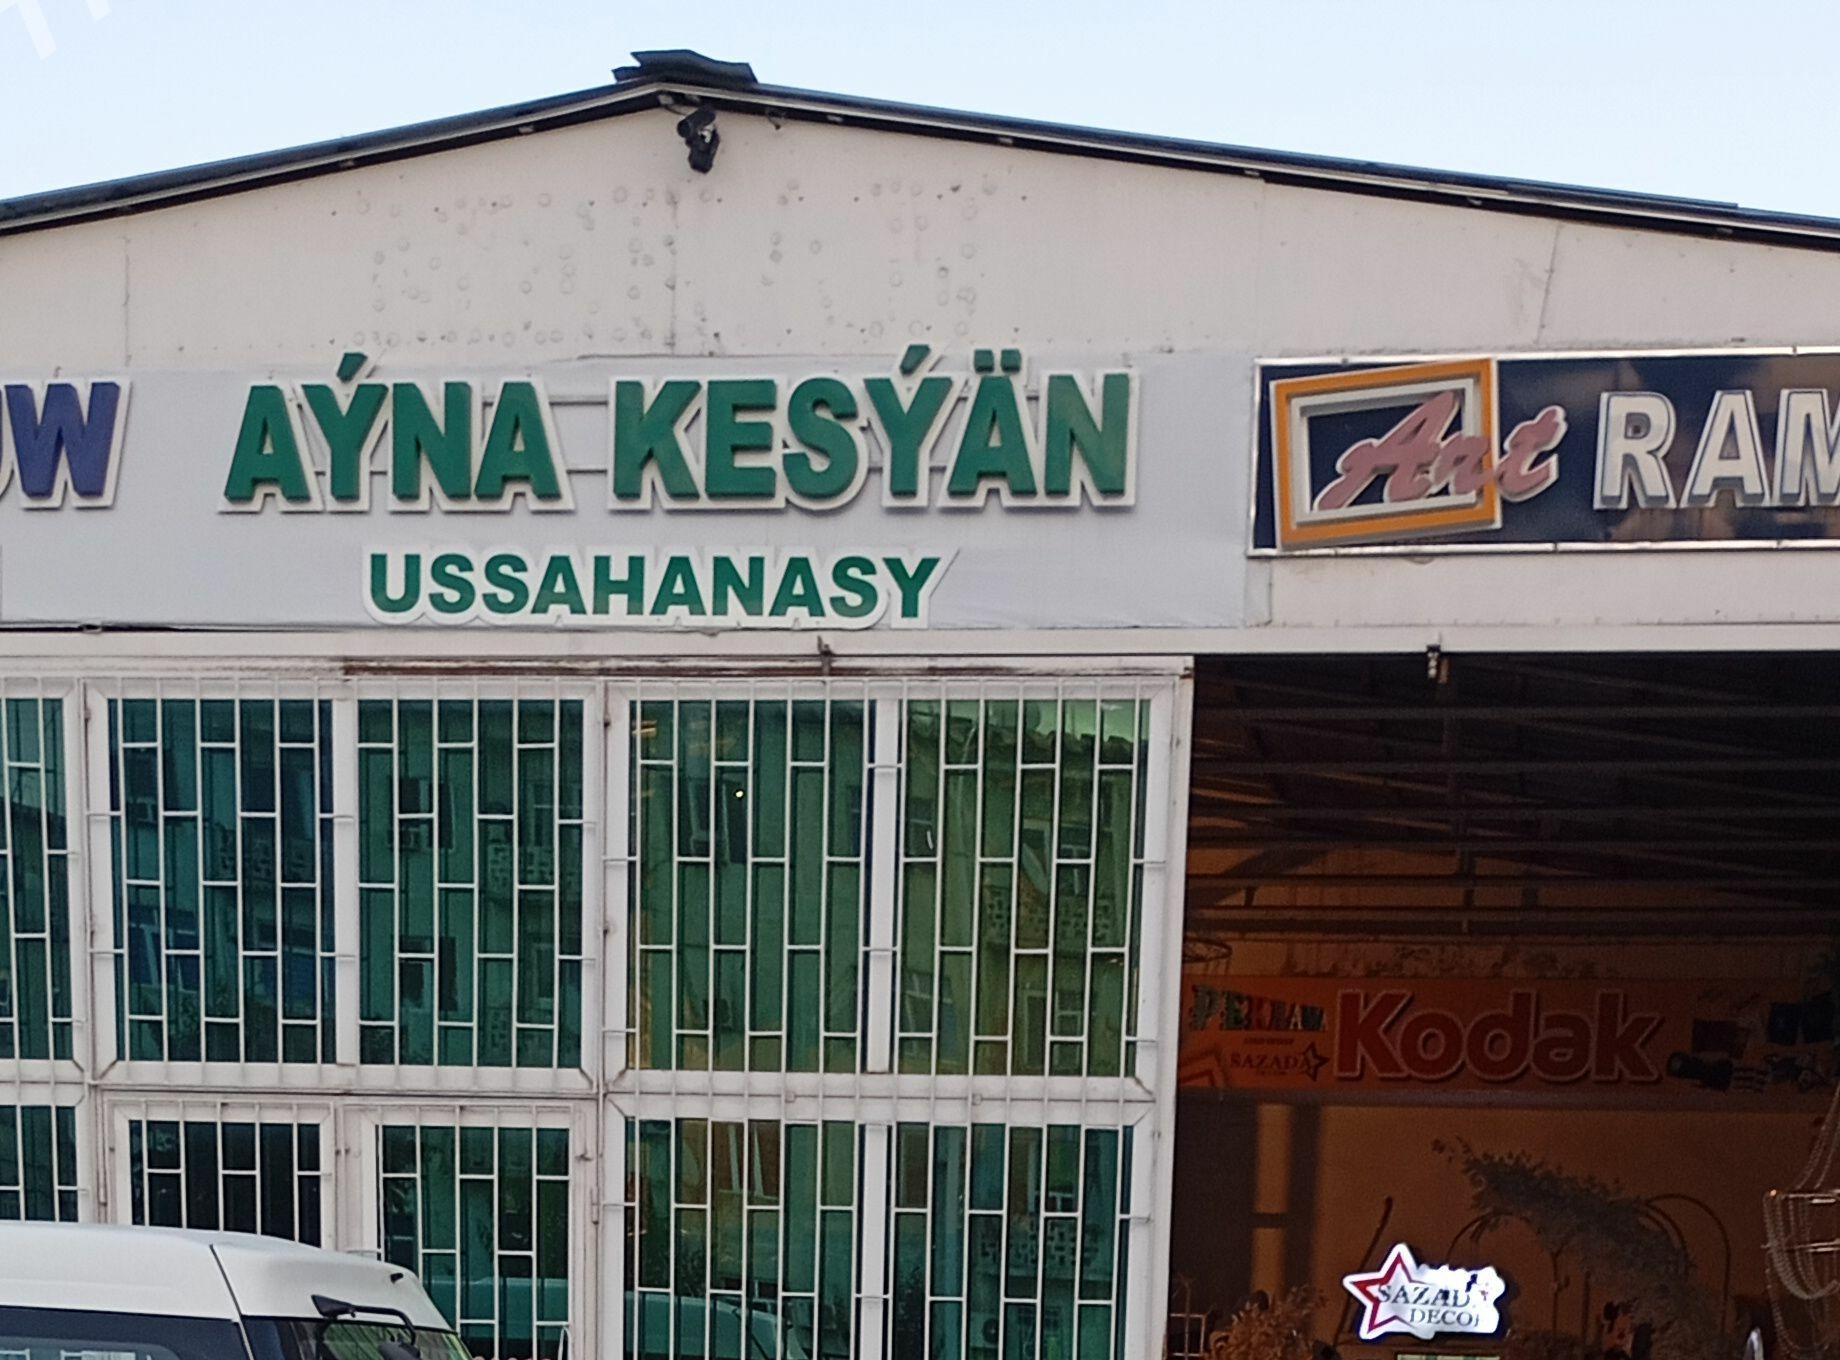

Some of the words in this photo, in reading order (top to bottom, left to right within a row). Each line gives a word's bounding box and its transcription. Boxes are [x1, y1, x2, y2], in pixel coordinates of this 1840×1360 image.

[0, 382, 121, 499] W
[224, 352, 561, 503] AÝNA
[613, 344, 1130, 500] KESÝÄN
[1312, 388, 1568, 514] Art
[370, 553, 941, 619] USSAHANASY
[1333, 987, 1667, 1086] Kodak
